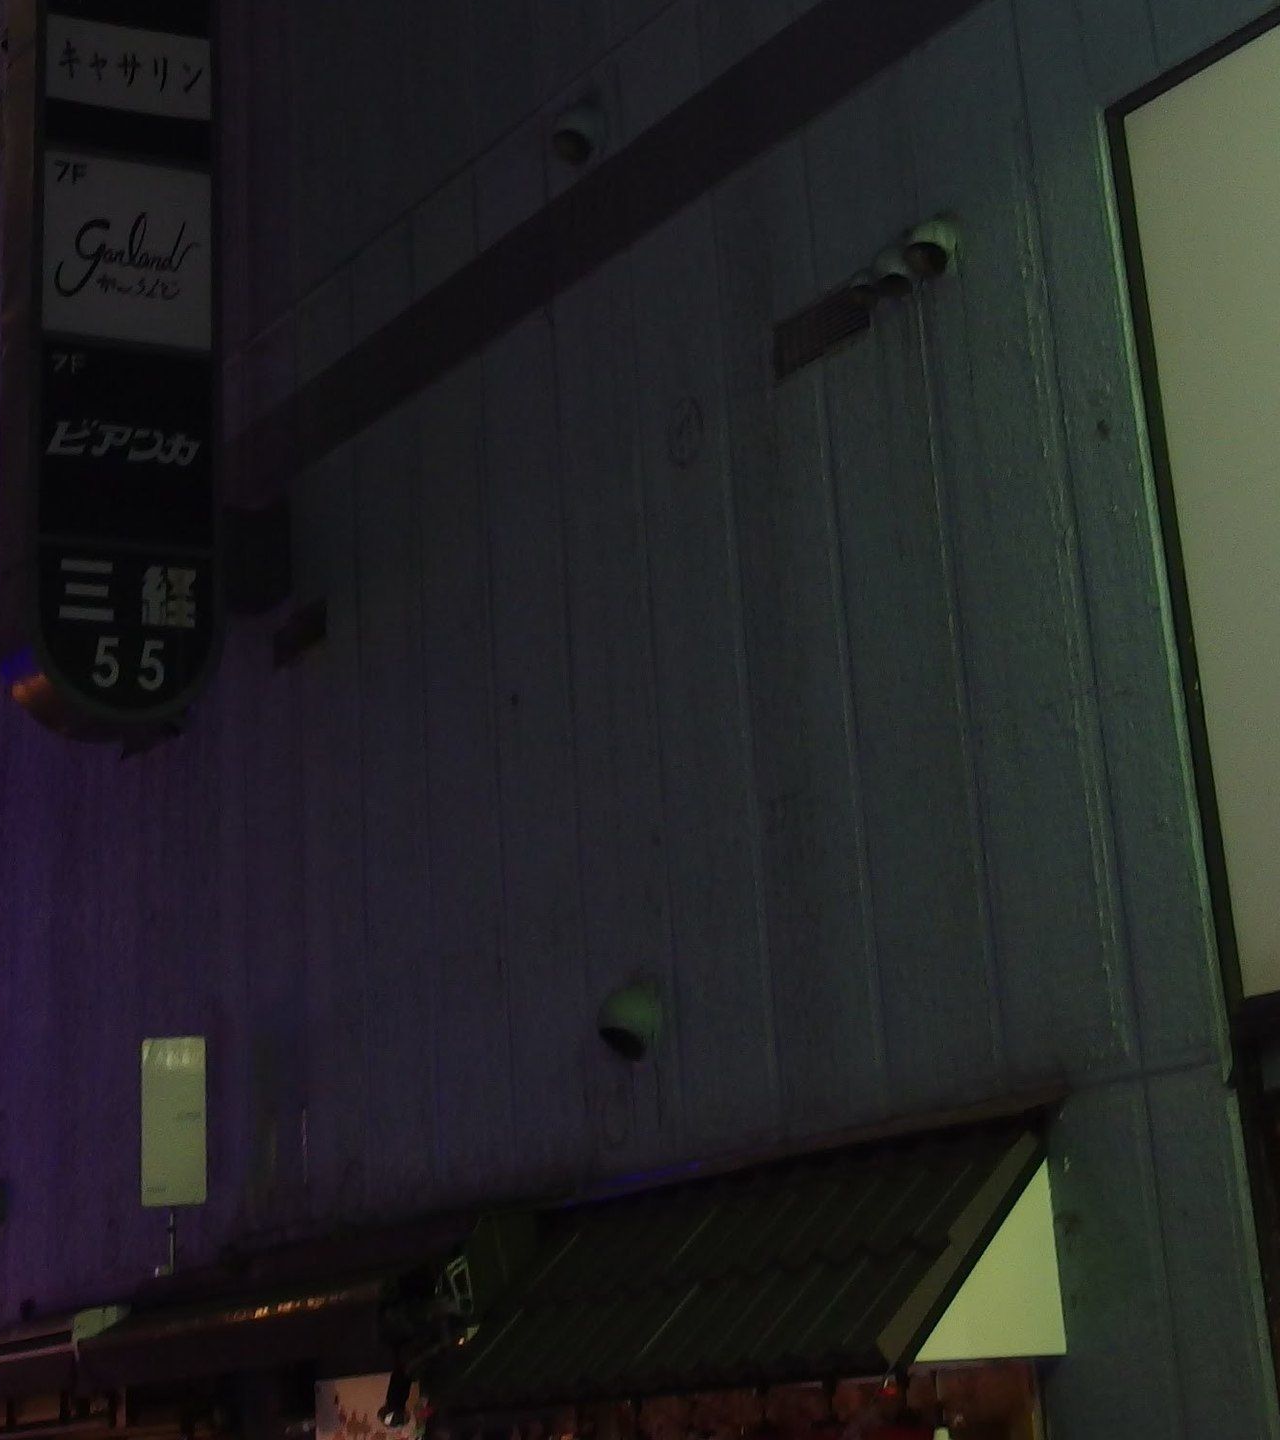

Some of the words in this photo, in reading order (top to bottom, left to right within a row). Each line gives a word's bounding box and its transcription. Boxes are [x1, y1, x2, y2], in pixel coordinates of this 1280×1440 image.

[59, 41, 202, 93] キャサリン
[54, 159, 88, 184] 7F
[54, 211, 200, 298] Garland
[46, 418, 201, 466] ビアンカ
[91, 636, 166, 691] 55
